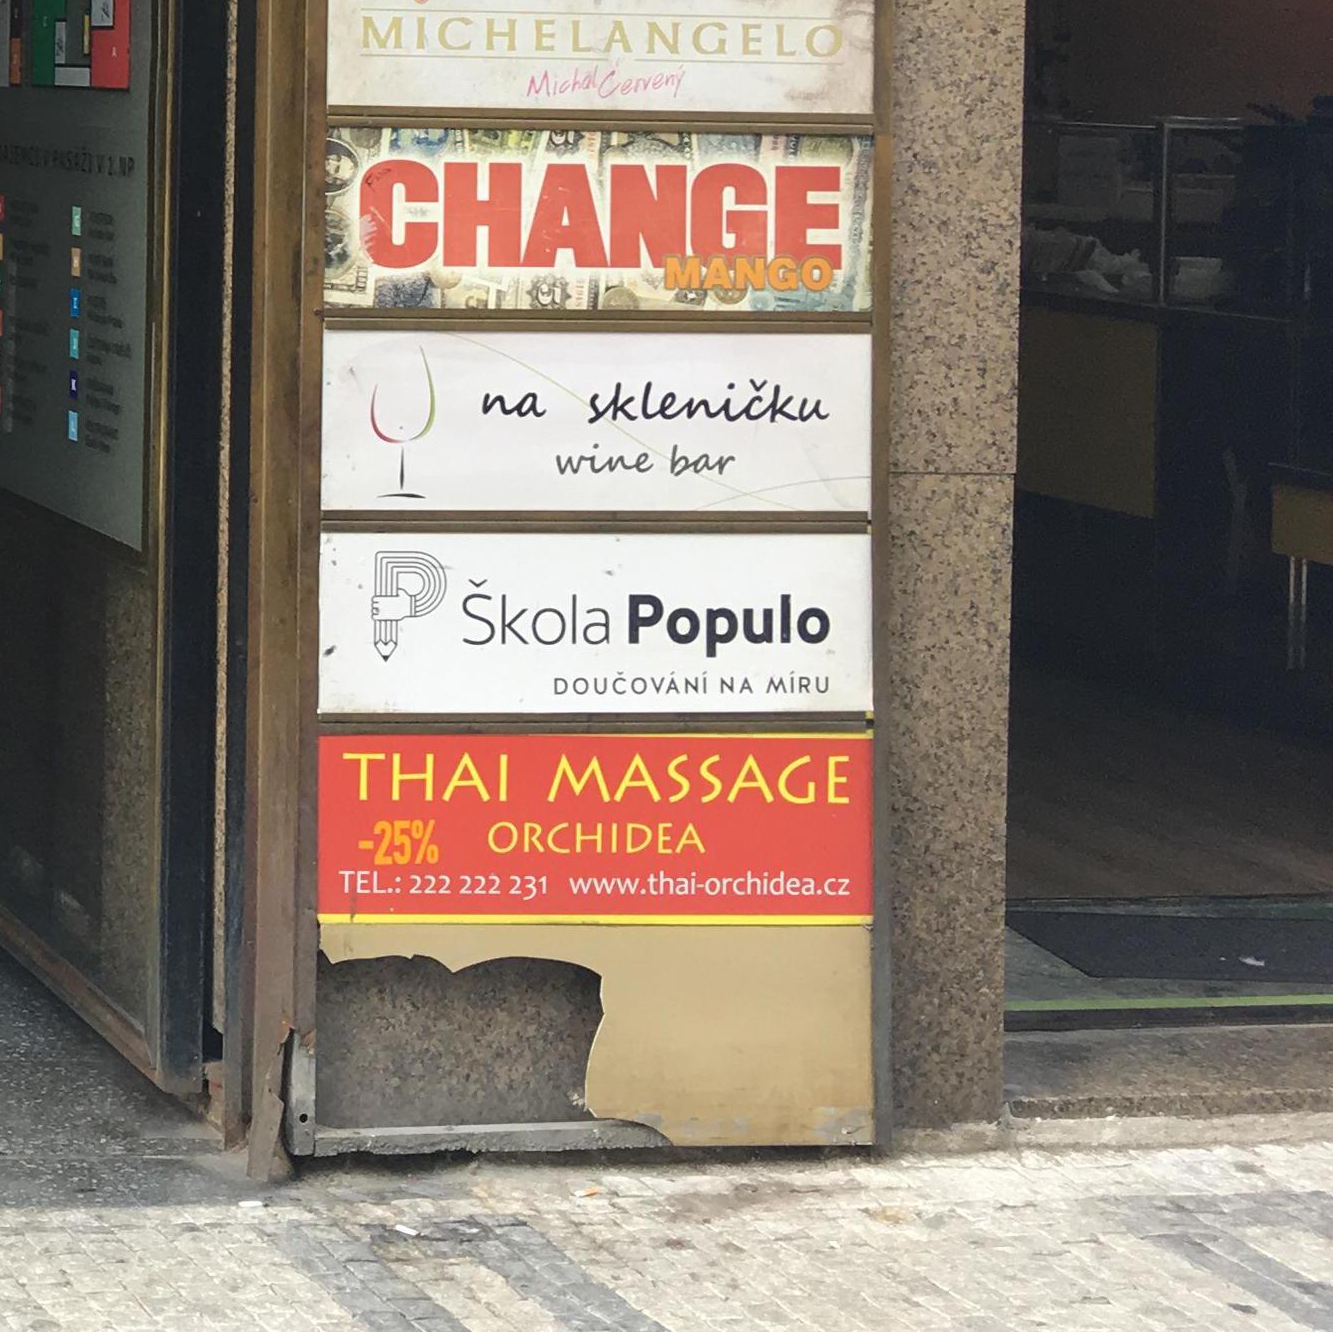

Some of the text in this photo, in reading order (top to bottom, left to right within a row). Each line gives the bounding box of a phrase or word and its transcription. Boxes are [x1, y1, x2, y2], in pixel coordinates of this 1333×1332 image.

[360, 15, 844, 58] MICHELANGELO
[359, 159, 843, 270] CHANGE
[663, 254, 835, 292] MANGO
[481, 379, 831, 423] na skleničku
[555, 442, 737, 476] wine bar
[461, 578, 831, 658] Škola Populo
[553, 670, 830, 696] DOUČOVÁNÍ NA MÍRU
[343, 752, 850, 804] THAI MASSAGE
[358, 819, 440, 866] -25%
[487, 821, 706, 855] ORCHIDEA
[339, 871, 850, 902] TEL.: 222 222 231 www.thai-orchidea.cz
